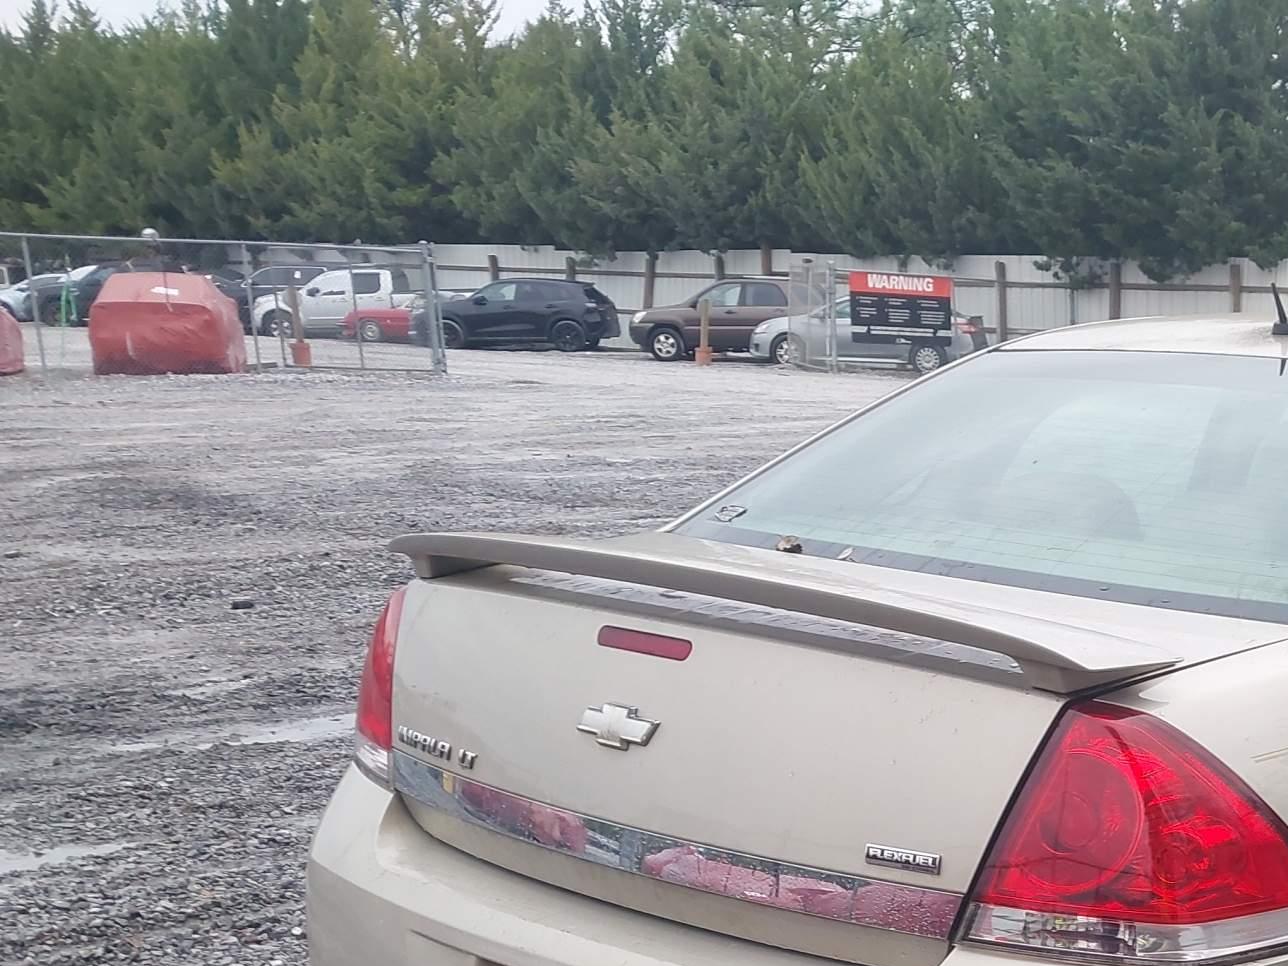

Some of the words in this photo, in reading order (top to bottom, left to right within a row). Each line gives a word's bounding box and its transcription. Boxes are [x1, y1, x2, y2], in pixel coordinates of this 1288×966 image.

[867, 273, 934, 292] WARNING
[398, 725, 451, 760] IMPALA
[458, 748, 478, 769] LT
[868, 847, 937, 868] FLEXFUEL
